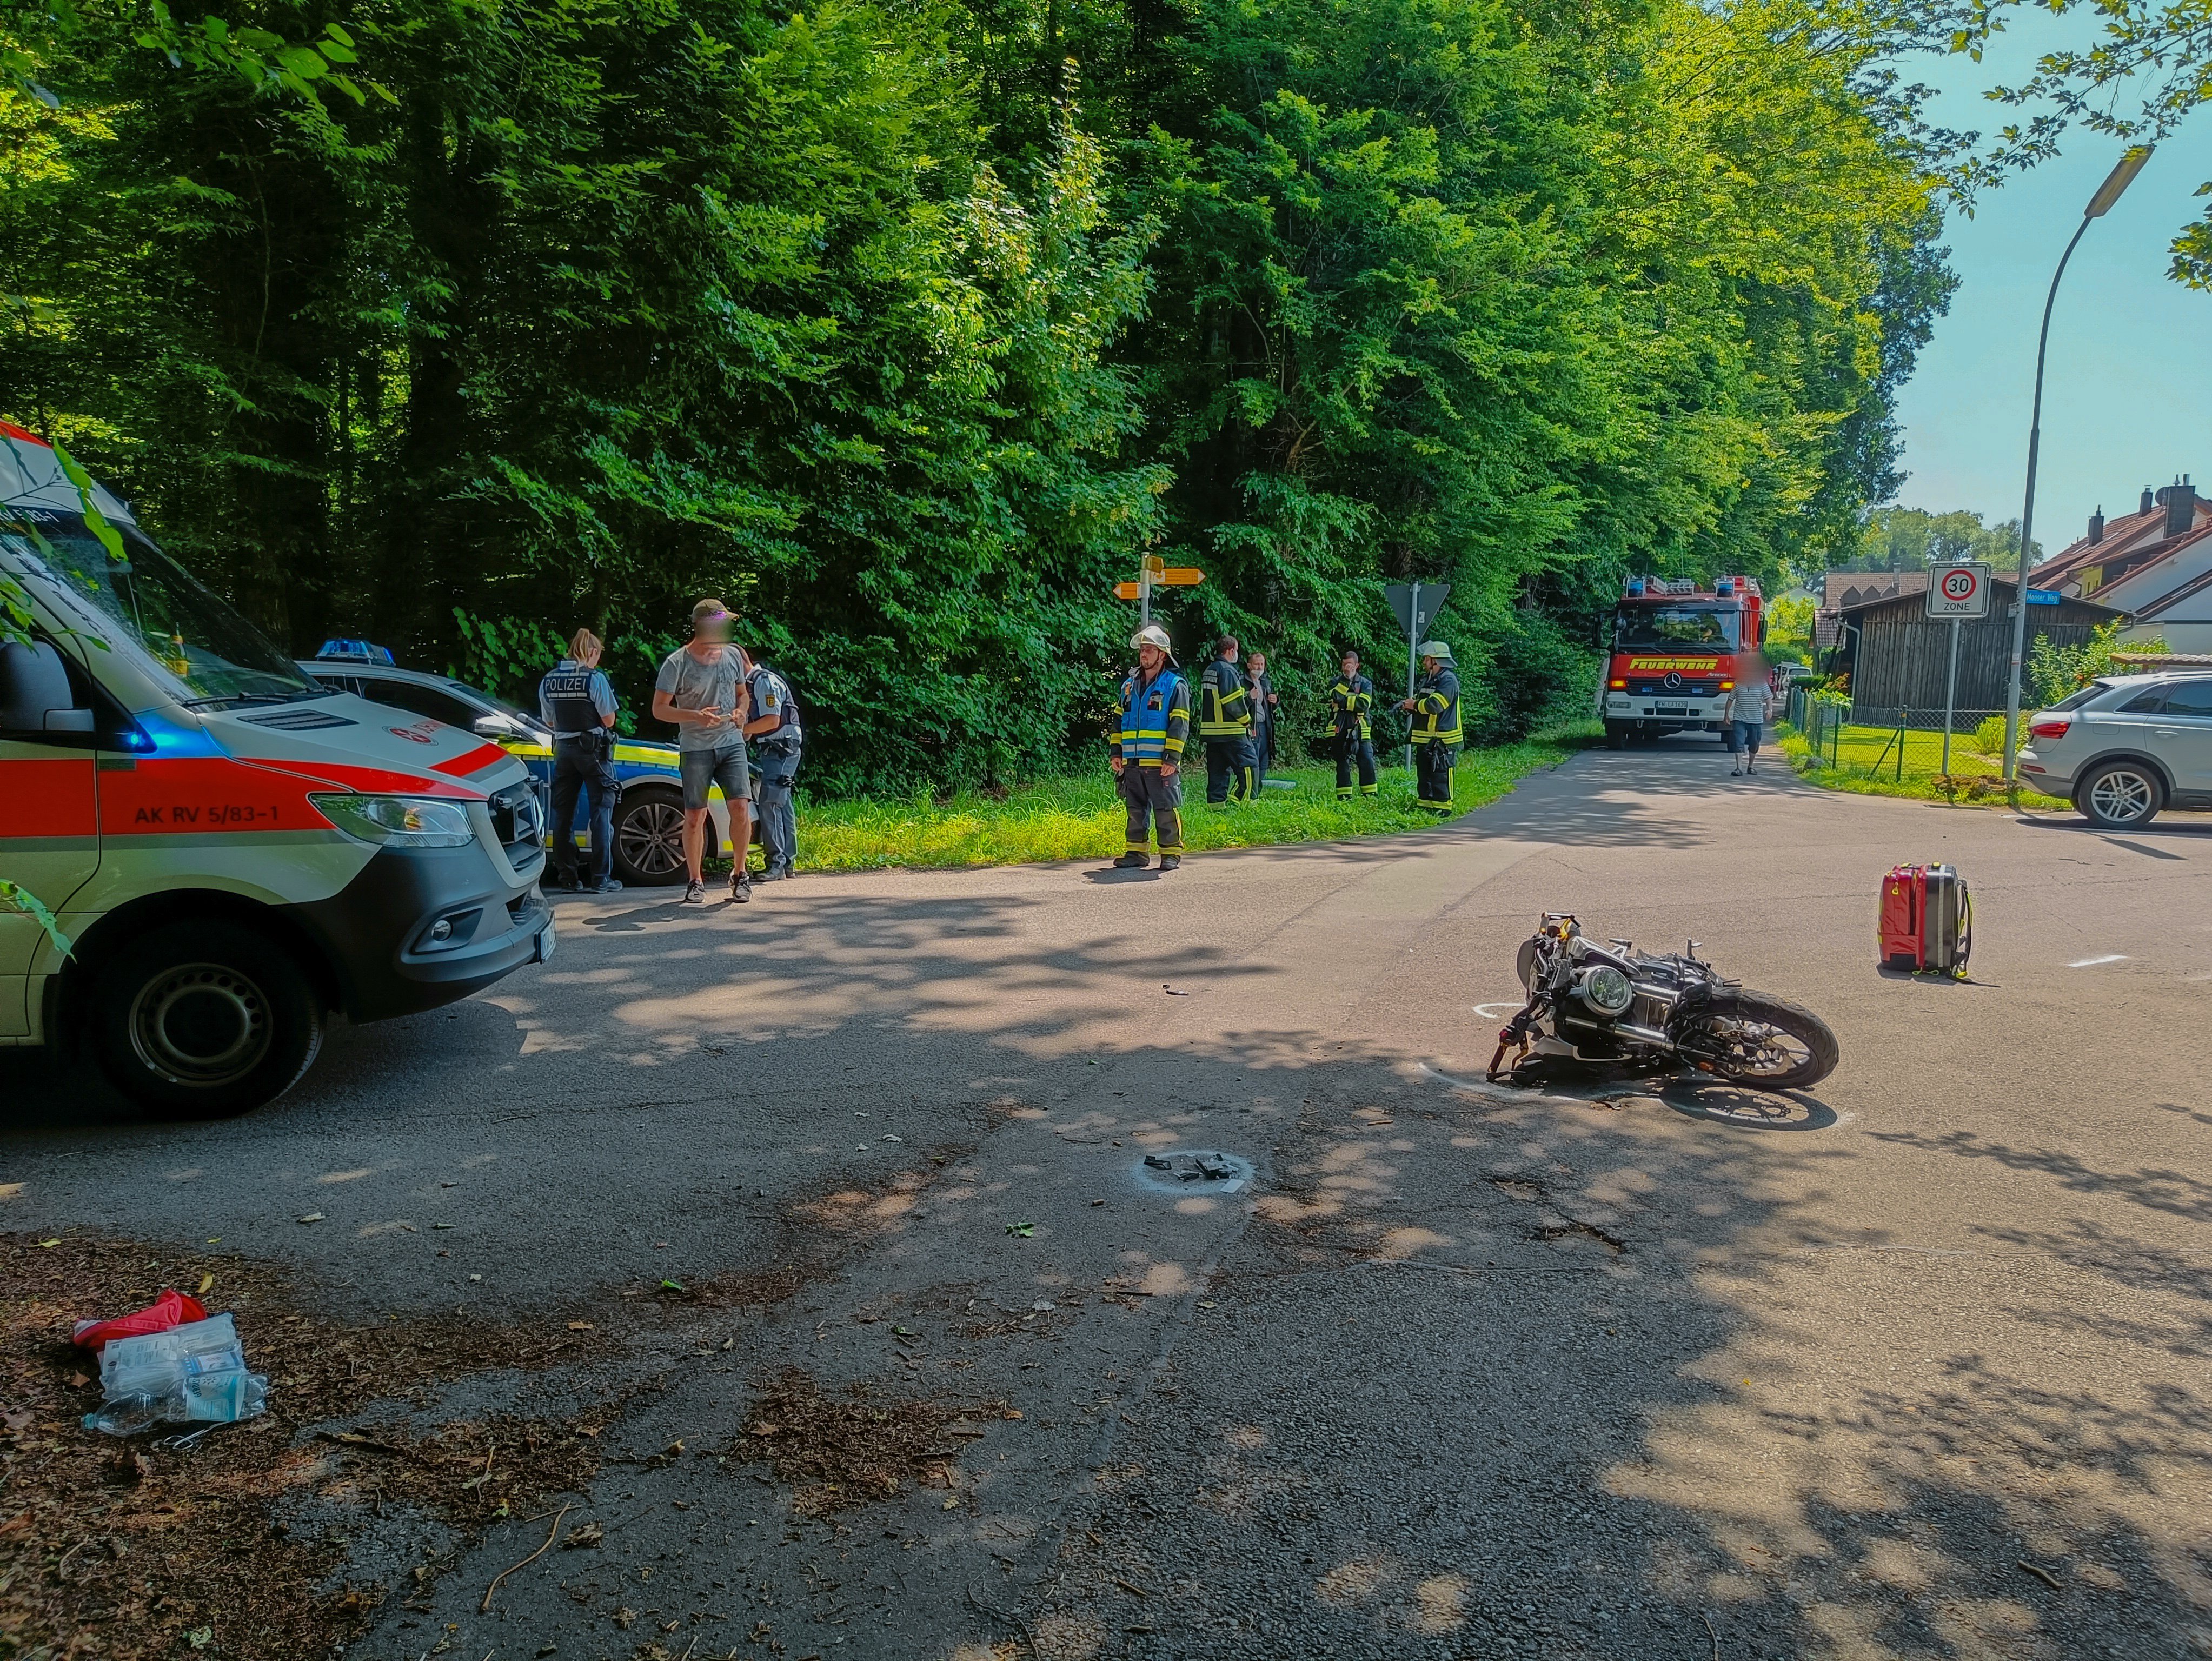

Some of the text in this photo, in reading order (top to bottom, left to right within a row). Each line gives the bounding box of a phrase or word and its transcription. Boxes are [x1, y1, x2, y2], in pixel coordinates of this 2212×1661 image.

[1949, 579, 1969, 592] 30
[2027, 592, 2058, 604] Mooser Weg
[1629, 658, 1718, 670] FEUERWEHR
[545, 677, 586, 692] POLIZEI
[136, 805, 277, 825] AK RV 5/83-1
